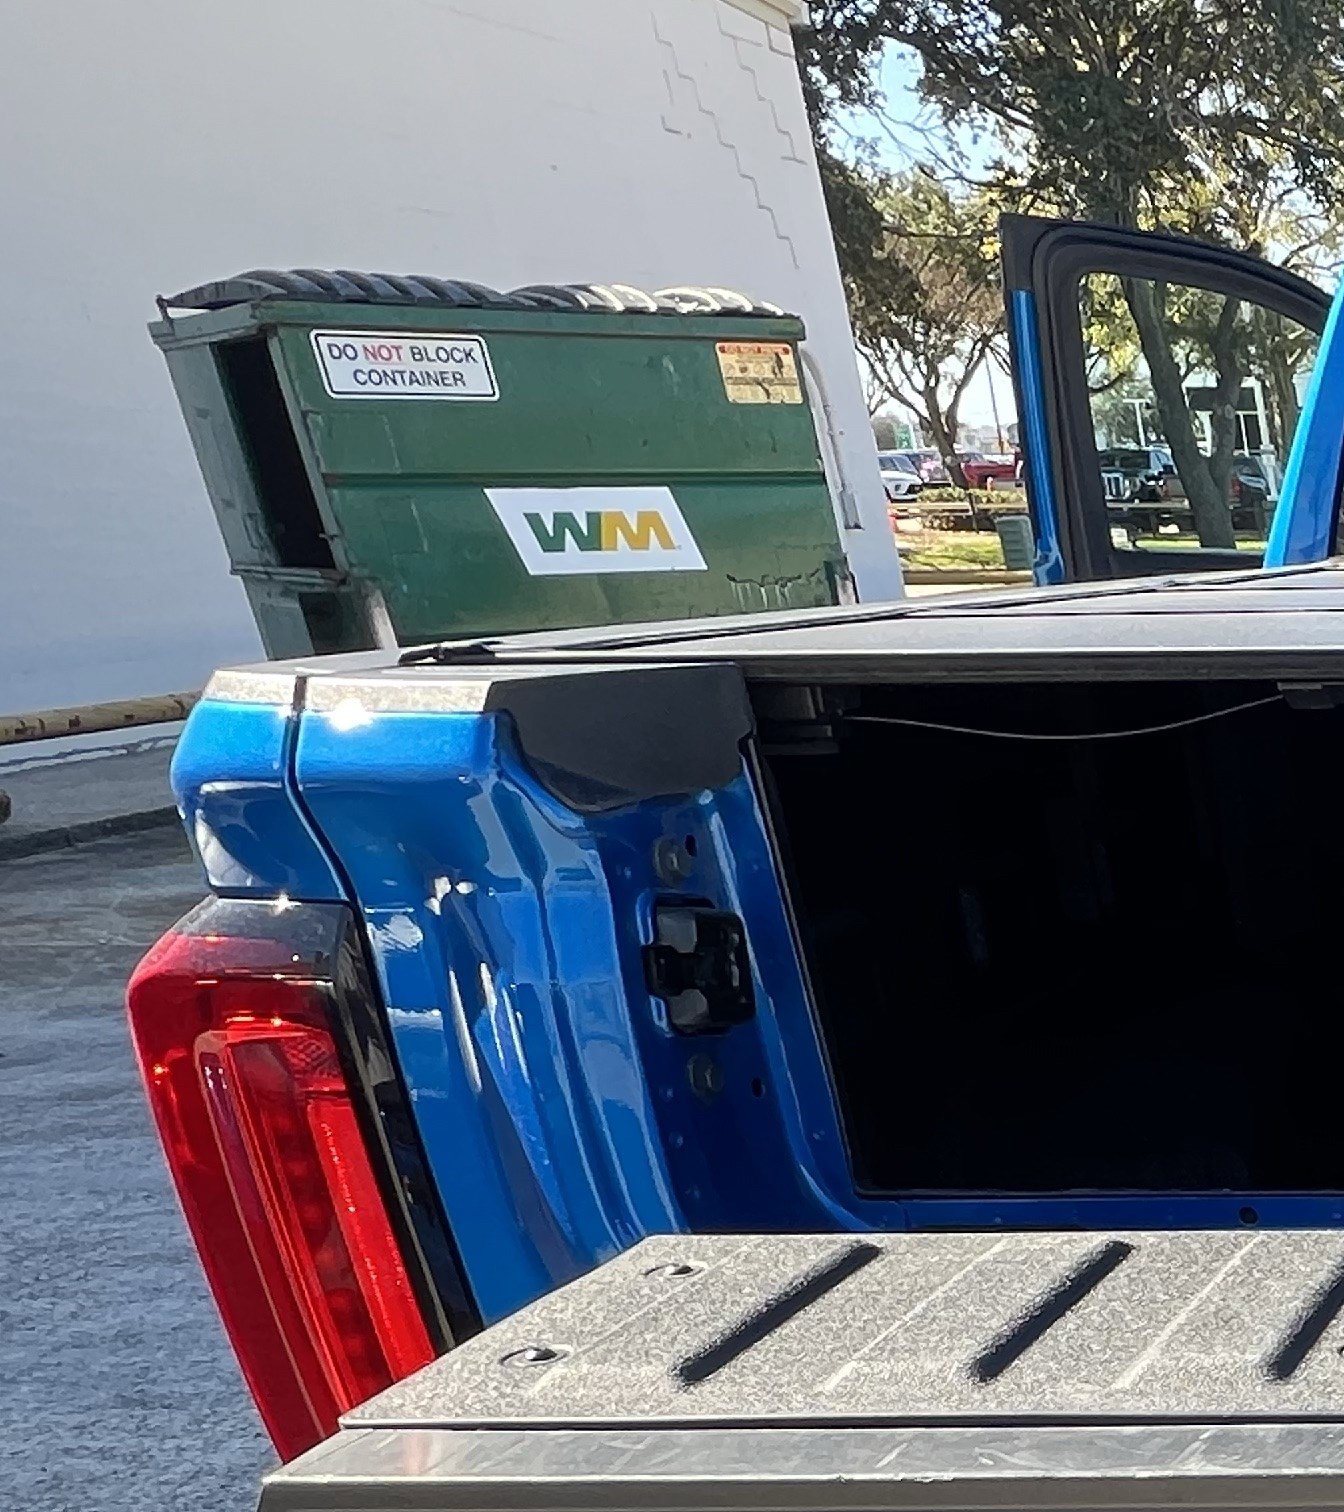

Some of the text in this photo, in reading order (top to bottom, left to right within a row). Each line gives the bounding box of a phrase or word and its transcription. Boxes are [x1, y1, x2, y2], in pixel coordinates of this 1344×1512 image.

[327, 343, 478, 364] DO NOT BLOCK
[353, 368, 466, 387] CONTAINER
[522, 510, 677, 553] WM
